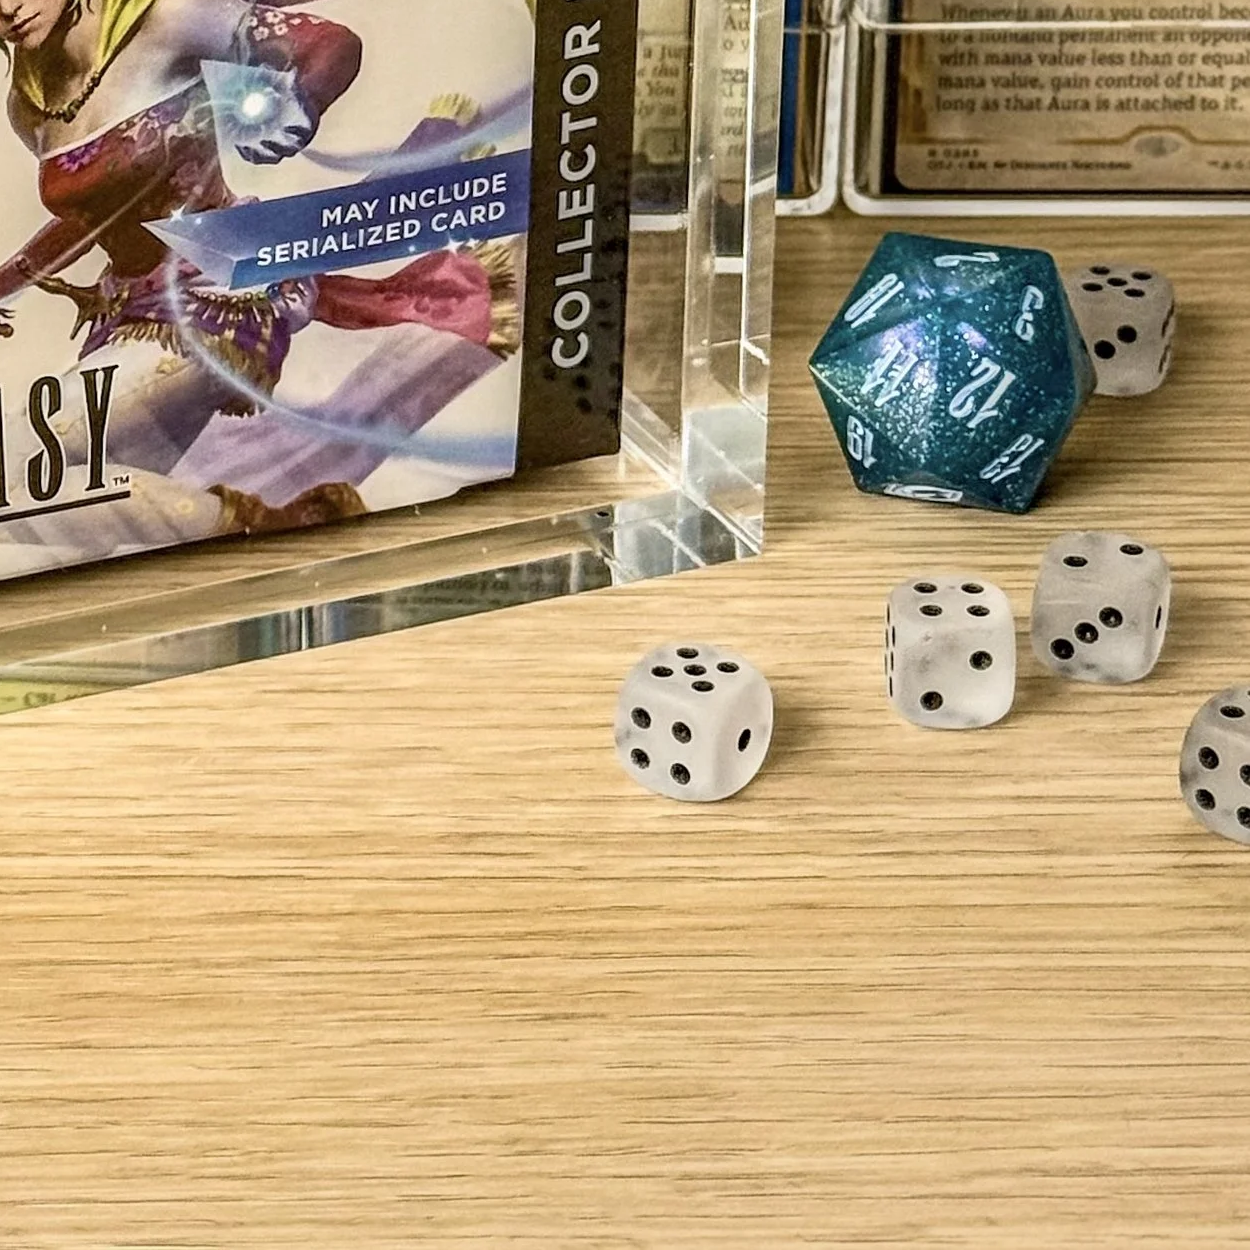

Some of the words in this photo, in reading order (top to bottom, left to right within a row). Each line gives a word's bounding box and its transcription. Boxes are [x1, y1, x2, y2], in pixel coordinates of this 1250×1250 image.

[1061, 4, 1105, 21] Aura
[1110, 7, 1143, 22] you
[1148, 2, 1213, 20] control
[938, 47, 979, 66] with
[984, 53, 1034, 66] mana
[1037, 48, 1087, 66] value
[1091, 48, 1125, 66] less
[1130, 50, 1173, 66] than
[1177, 53, 1197, 66] or
[1201, 48, 1250, 69] equal
[937, 76, 987, 89] mana
[1050, 72, 1091, 93] gain
[1094, 72, 1159, 89] control
[1164, 71, 1184, 88] of
[1187, 72, 1225, 88] that
[935, 94, 976, 116] long
[980, 99, 1000, 111] as
[1004, 94, 1043, 111] that
[1048, 96, 1090, 111] Aura
[1094, 95, 1110, 111] is
[1114, 94, 1196, 111] attached
[1200, 97, 1220, 111] to
[1224, 95, 1244, 111] it.
[320, 198, 380, 229] MAY
[389, 172, 508, 216] INCLUDE
[551, 16, 604, 372] COLLECTOR
[256, 218, 422, 267] SERIALIZED
[430, 200, 507, 232] CARD
[949, 356, 1017, 430] 12
